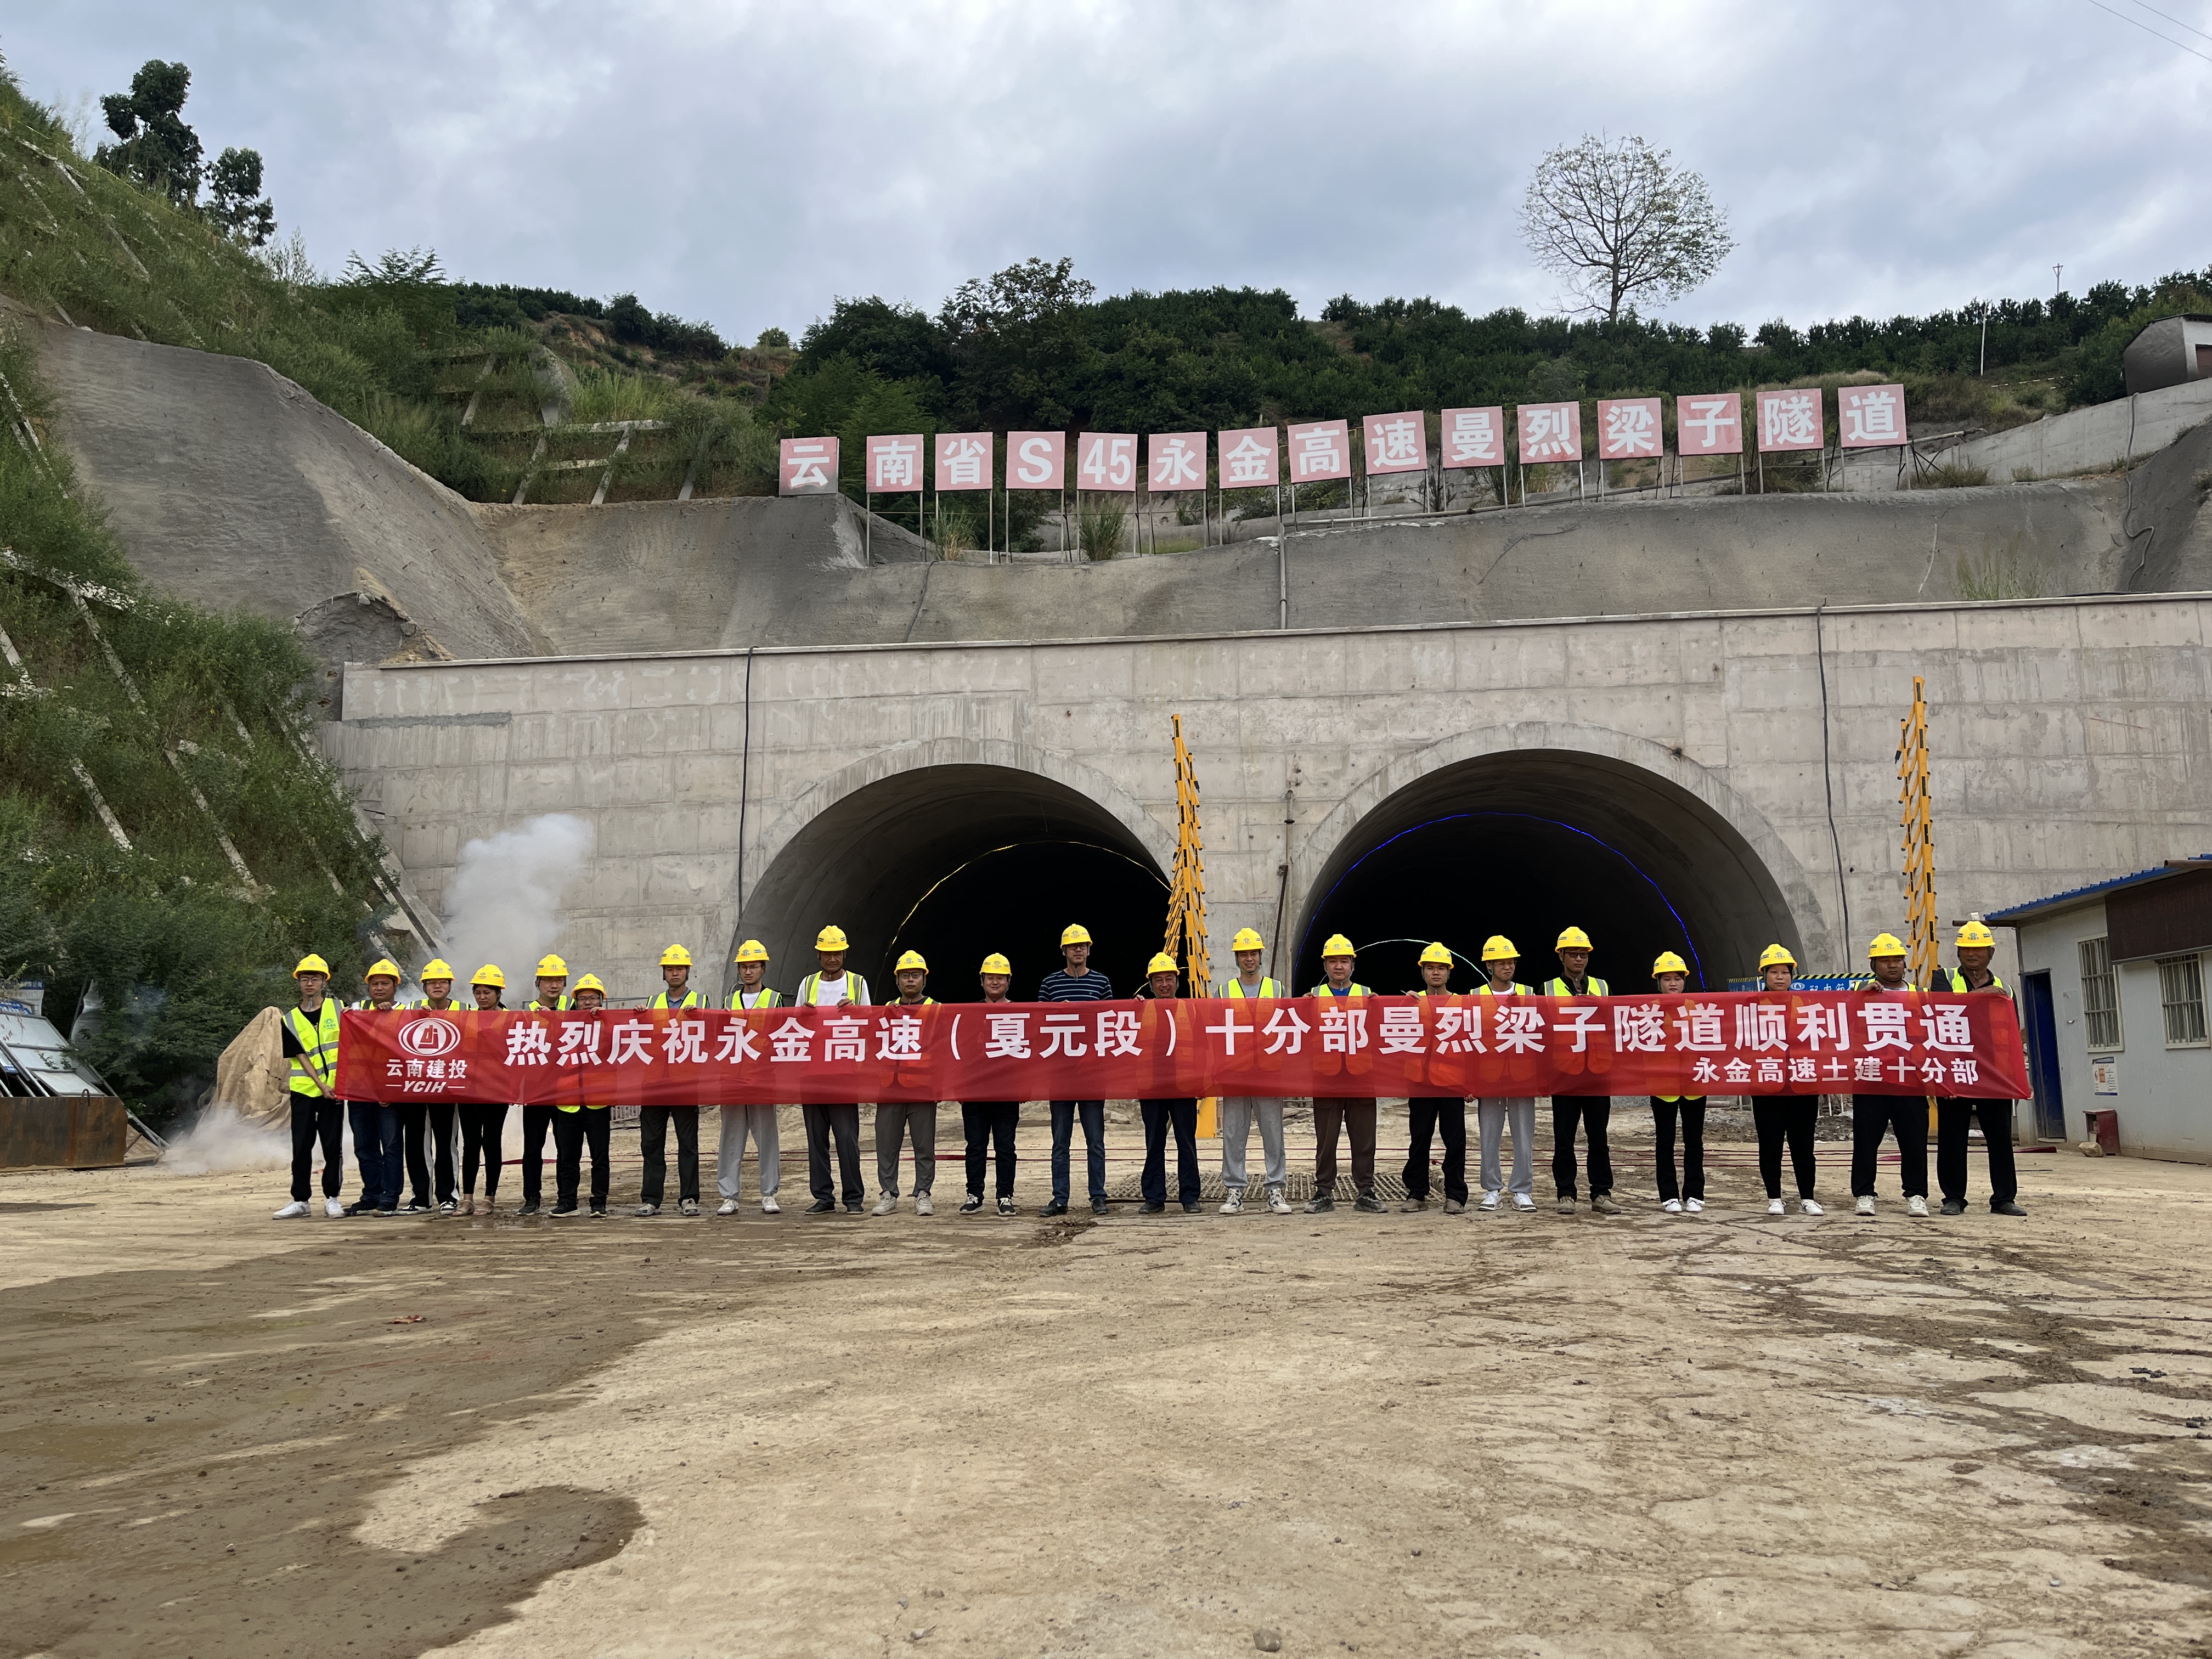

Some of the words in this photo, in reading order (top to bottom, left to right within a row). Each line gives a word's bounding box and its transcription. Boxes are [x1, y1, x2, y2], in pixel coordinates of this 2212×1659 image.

[386, 1058, 467, 1079] 云南建投
[1692, 1057, 1978, 1085] 永金高速土建十分部
[403, 1081, 447, 1093] YCIH
